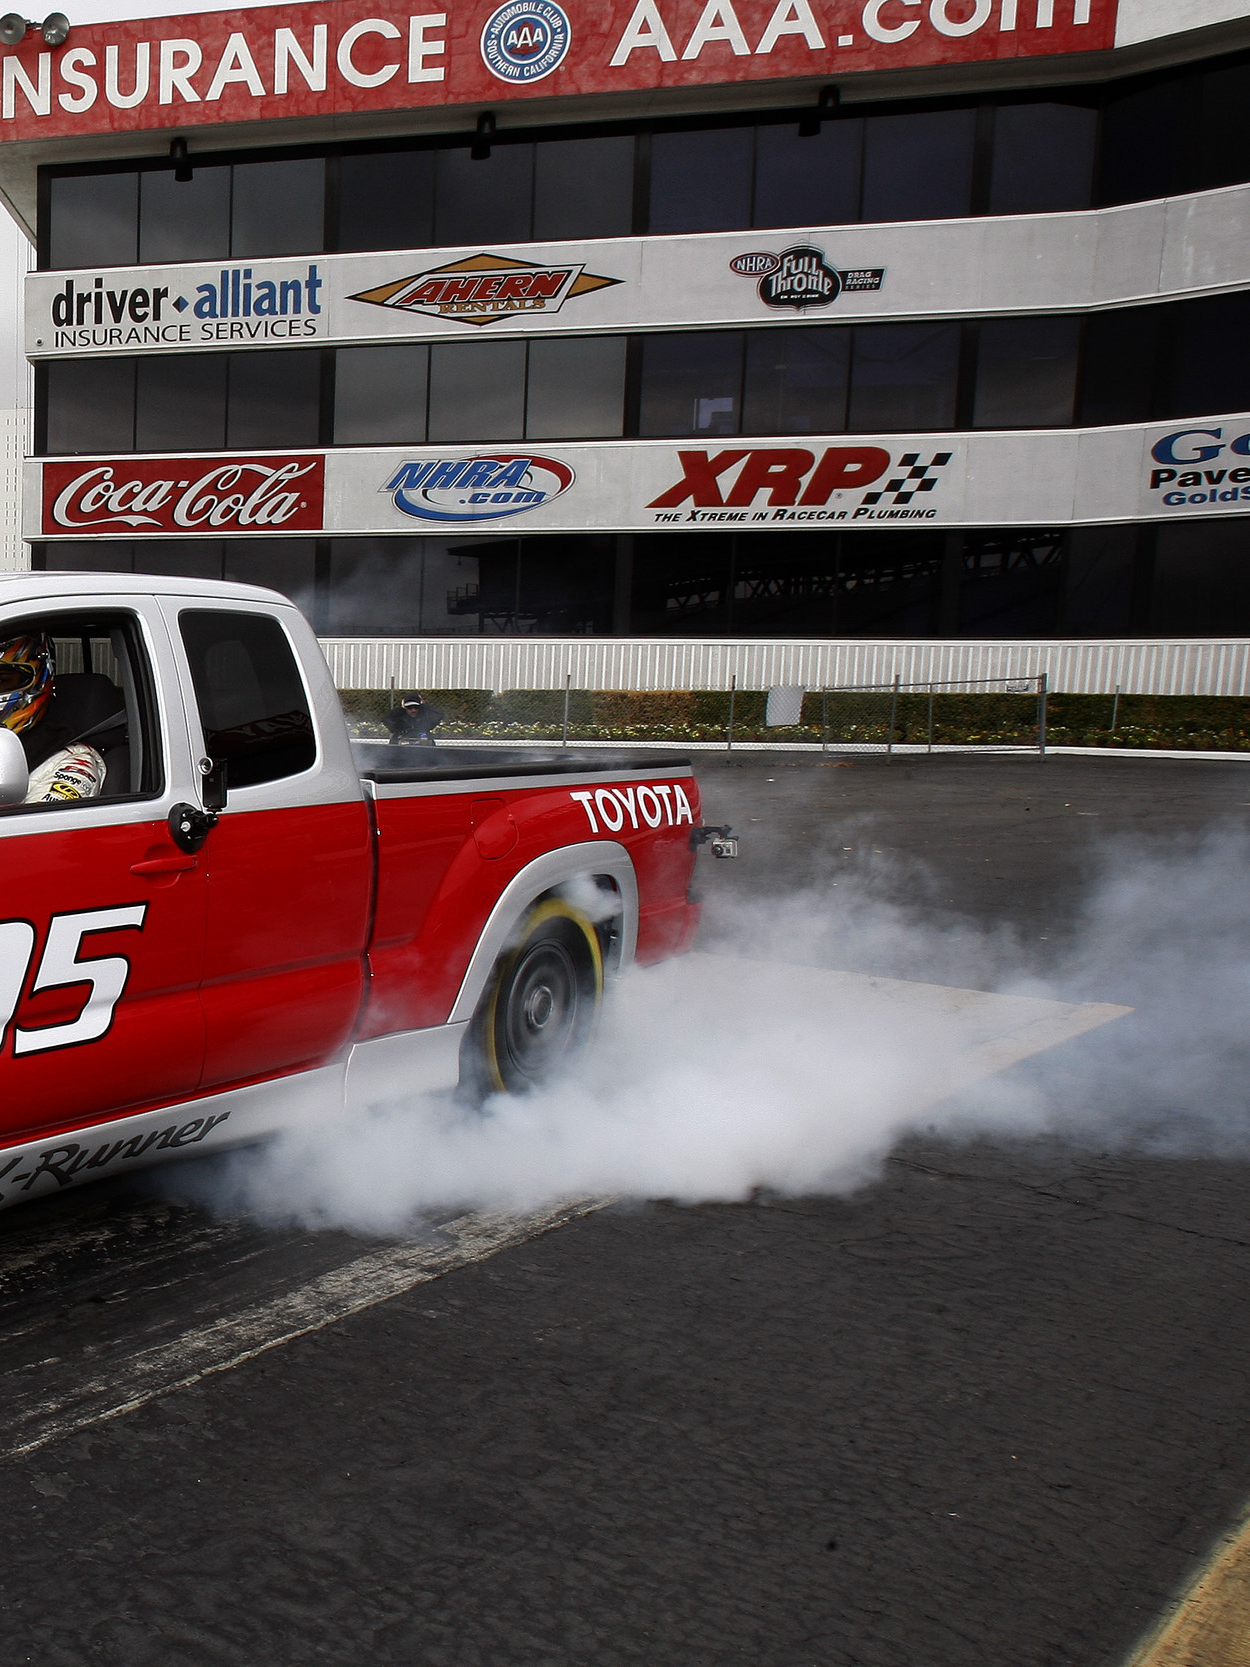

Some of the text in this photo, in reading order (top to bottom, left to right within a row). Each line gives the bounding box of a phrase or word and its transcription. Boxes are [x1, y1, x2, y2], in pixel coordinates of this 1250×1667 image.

[491, 2, 563, 34] AUTOMOBILE CLUB
[507, 27, 543, 48] AAA
[487, 33, 564, 77] SOUTHERN CALIFORNIA
[736, 257, 773, 271] NHRA
[52, 265, 322, 327] driver alliant
[404, 272, 570, 305] AHERN
[437, 299, 547, 314] RENTALS
[54, 318, 317, 348] INSURANCE SERVICES
[386, 459, 533, 490] NHRA
[644, 447, 892, 509] XRP
[53, 461, 317, 528] Coca-Cola
[458, 491, 547, 505] .com
[654, 512, 682, 522] THE
[752, 511, 768, 521] IN
[771, 509, 848, 521] RACECAR
[851, 507, 937, 519] PLUMBING
[570, 784, 693, 833] TOYOTA
